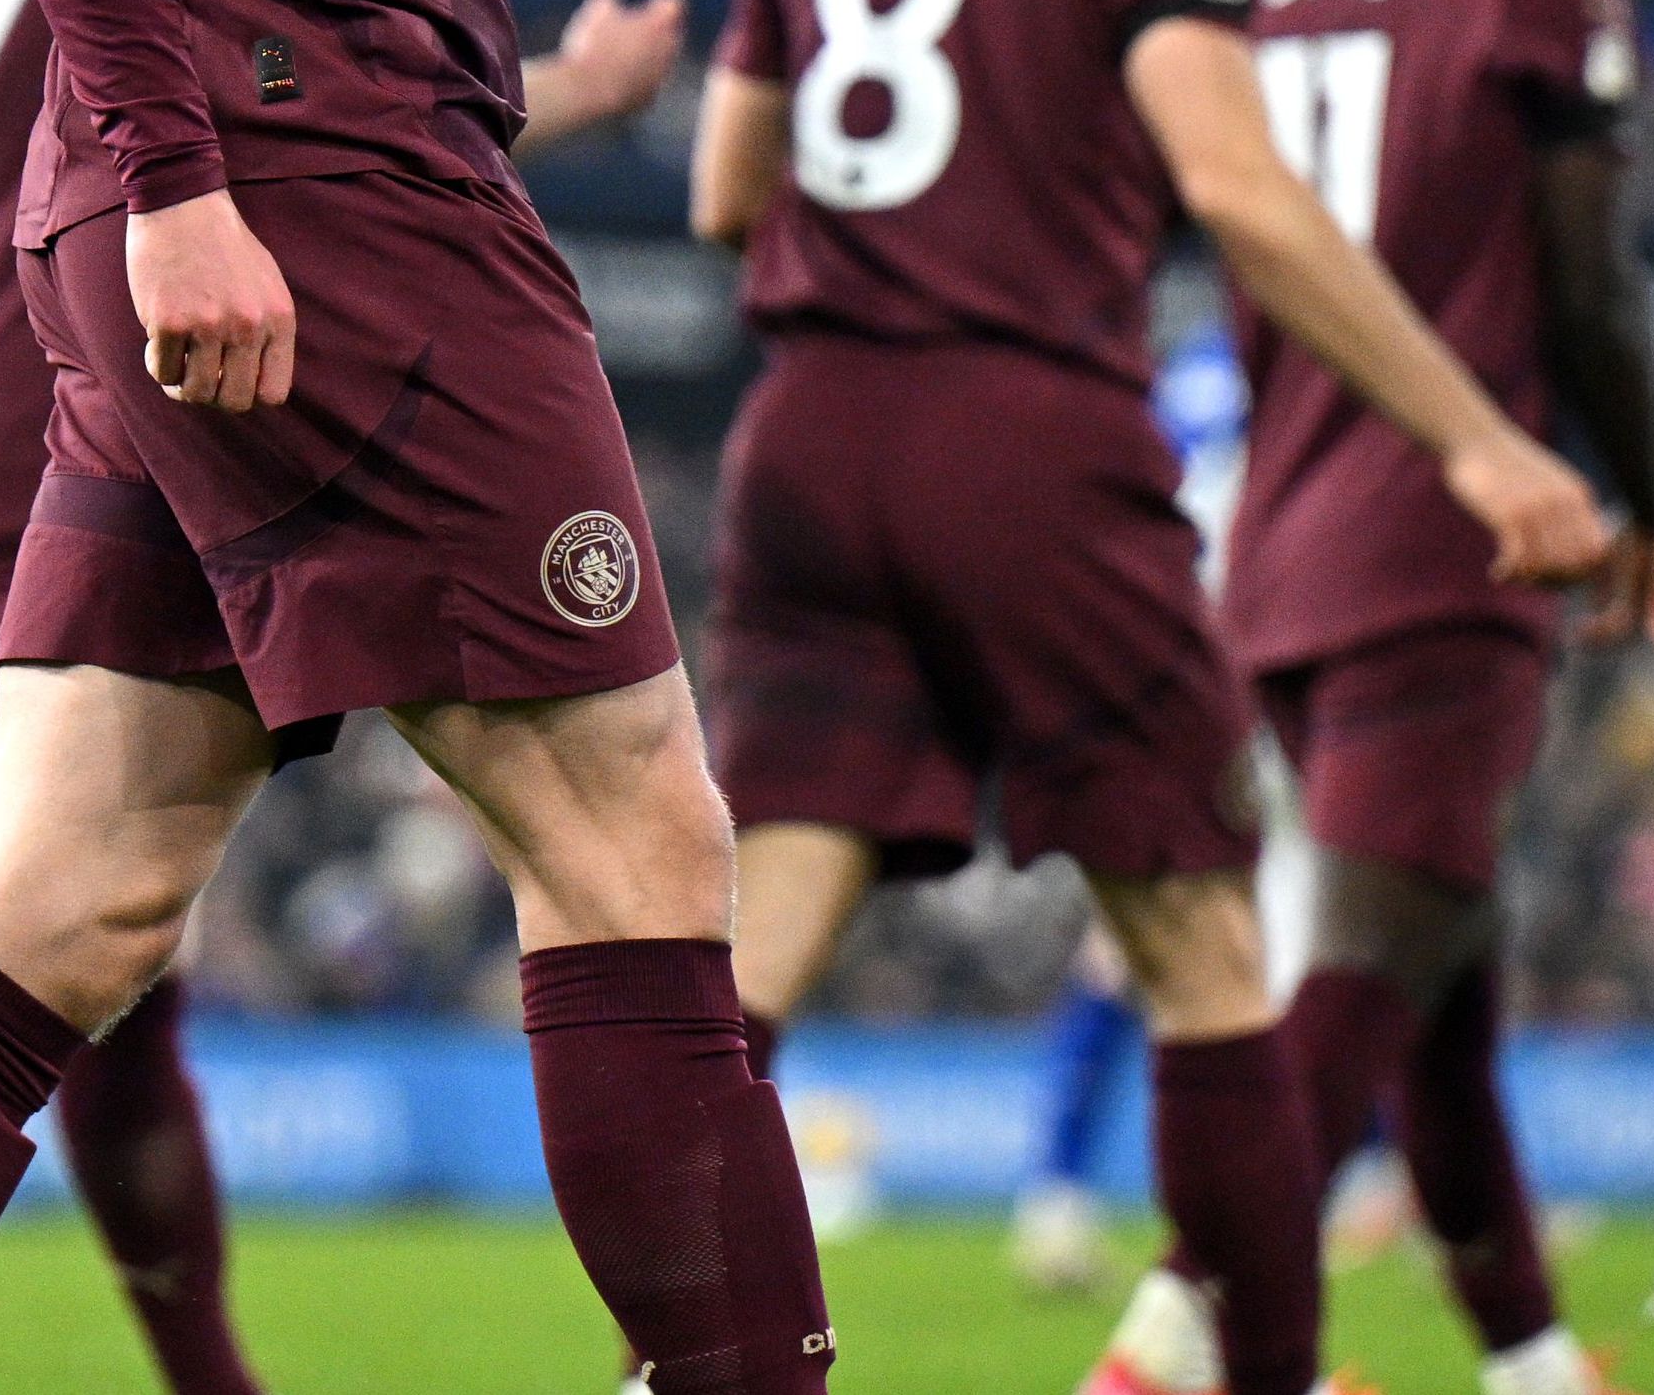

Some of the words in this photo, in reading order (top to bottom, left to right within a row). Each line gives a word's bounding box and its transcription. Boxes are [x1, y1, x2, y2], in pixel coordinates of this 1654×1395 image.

[1255, 29, 1394, 245] 11
[552, 520, 626, 565] MANCHESTER
[592, 601, 620, 618] CITY
